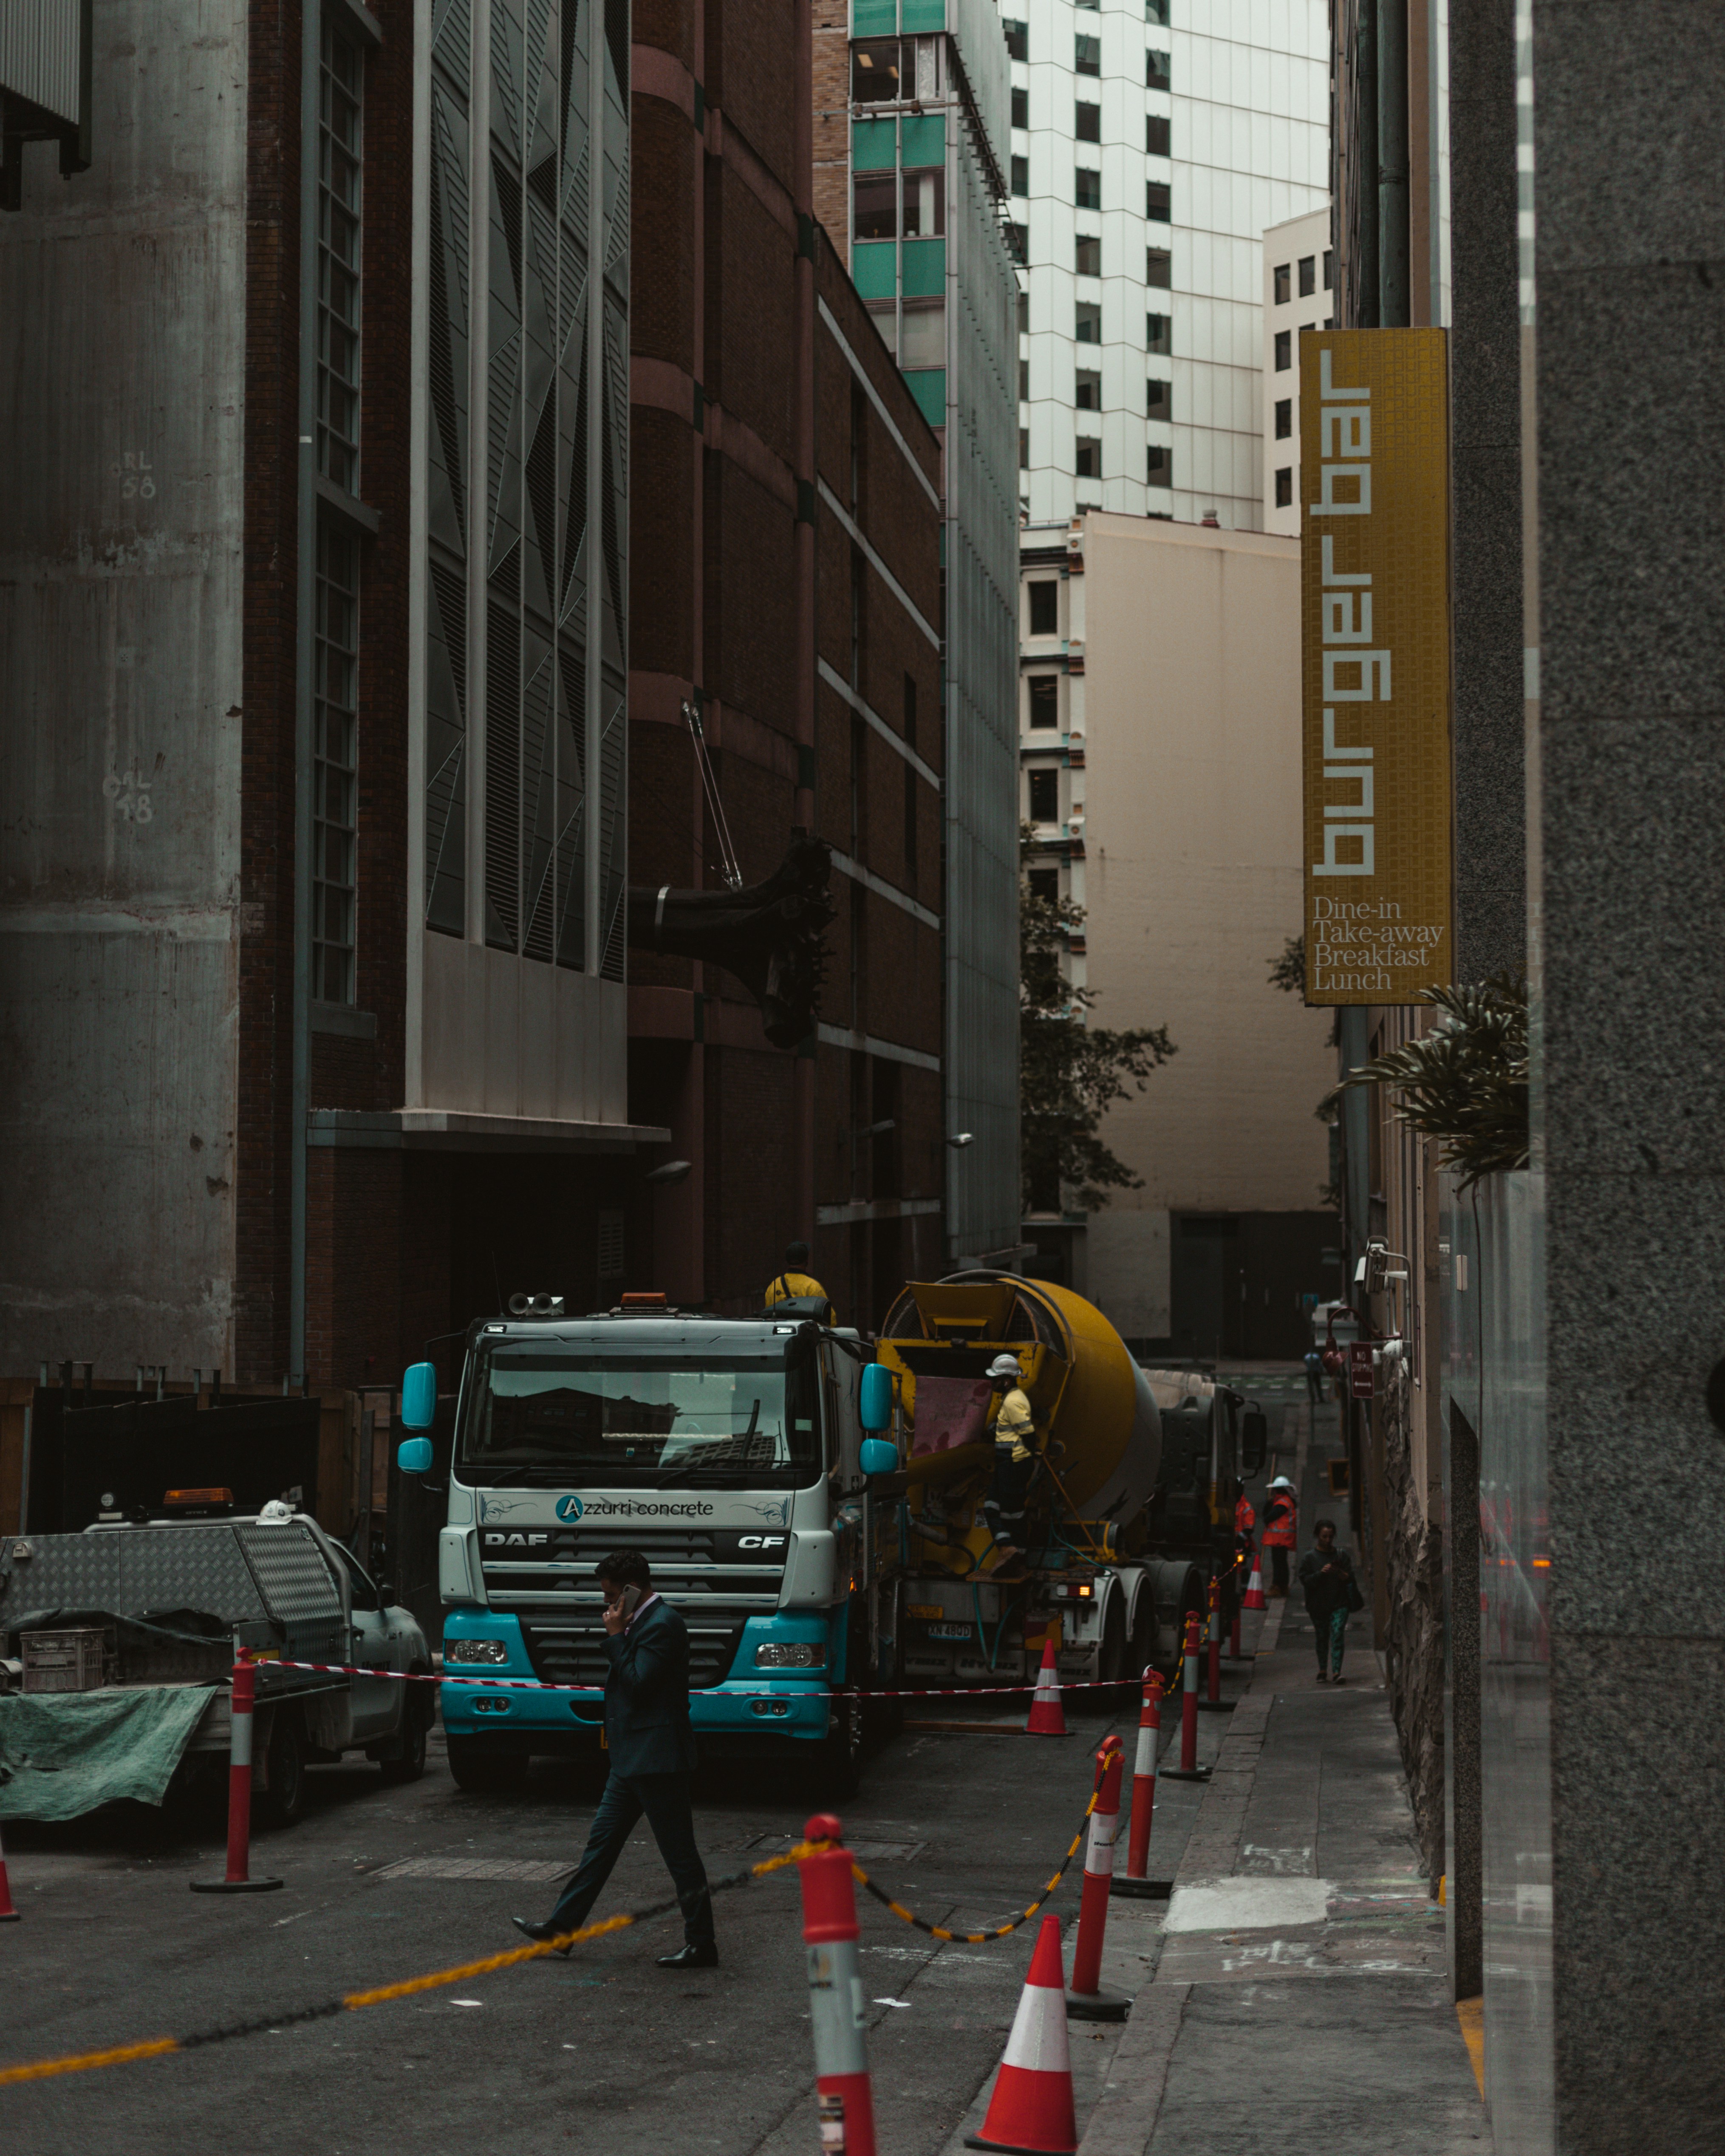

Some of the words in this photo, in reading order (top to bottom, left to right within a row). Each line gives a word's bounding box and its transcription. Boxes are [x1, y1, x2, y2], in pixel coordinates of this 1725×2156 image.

[1309, 350, 1372, 515] bar
[1313, 535, 1391, 876] burger
[1313, 897, 1401, 919] Dine-in
[1313, 921, 1444, 947] Take-away
[1314, 944, 1429, 966] Breakfast
[1313, 968, 1392, 990] Lunch
[1357, 1351, 1366, 1360] NO
[560, 1498, 631, 1518] Azzurri
[637, 1501, 713, 1515] concrete
[485, 1533, 548, 1546] DAF
[738, 1536, 785, 1549] CF
